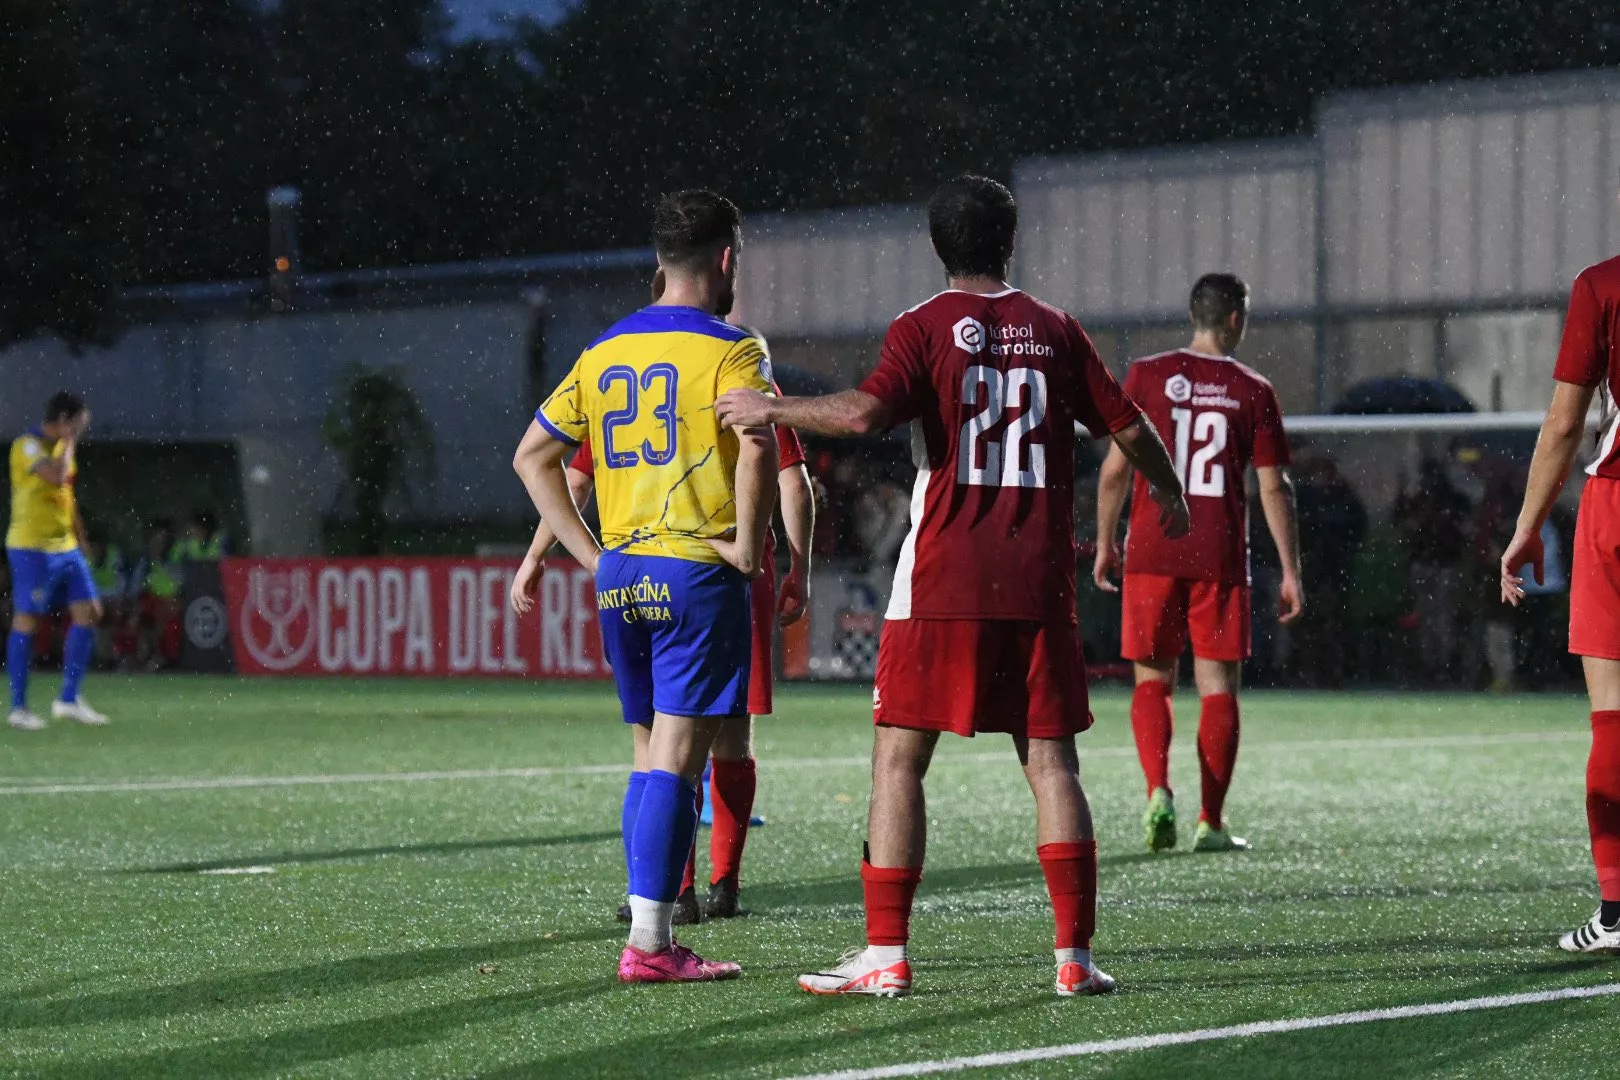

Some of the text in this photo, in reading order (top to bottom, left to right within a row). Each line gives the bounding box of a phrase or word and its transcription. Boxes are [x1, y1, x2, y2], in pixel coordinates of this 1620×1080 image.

[990, 340, 1054, 357] emotion
[598, 362, 679, 469] 23
[957, 365, 1047, 488] 22
[1171, 407, 1228, 497] 12
[316, 566, 612, 674] COPA DEL RE
